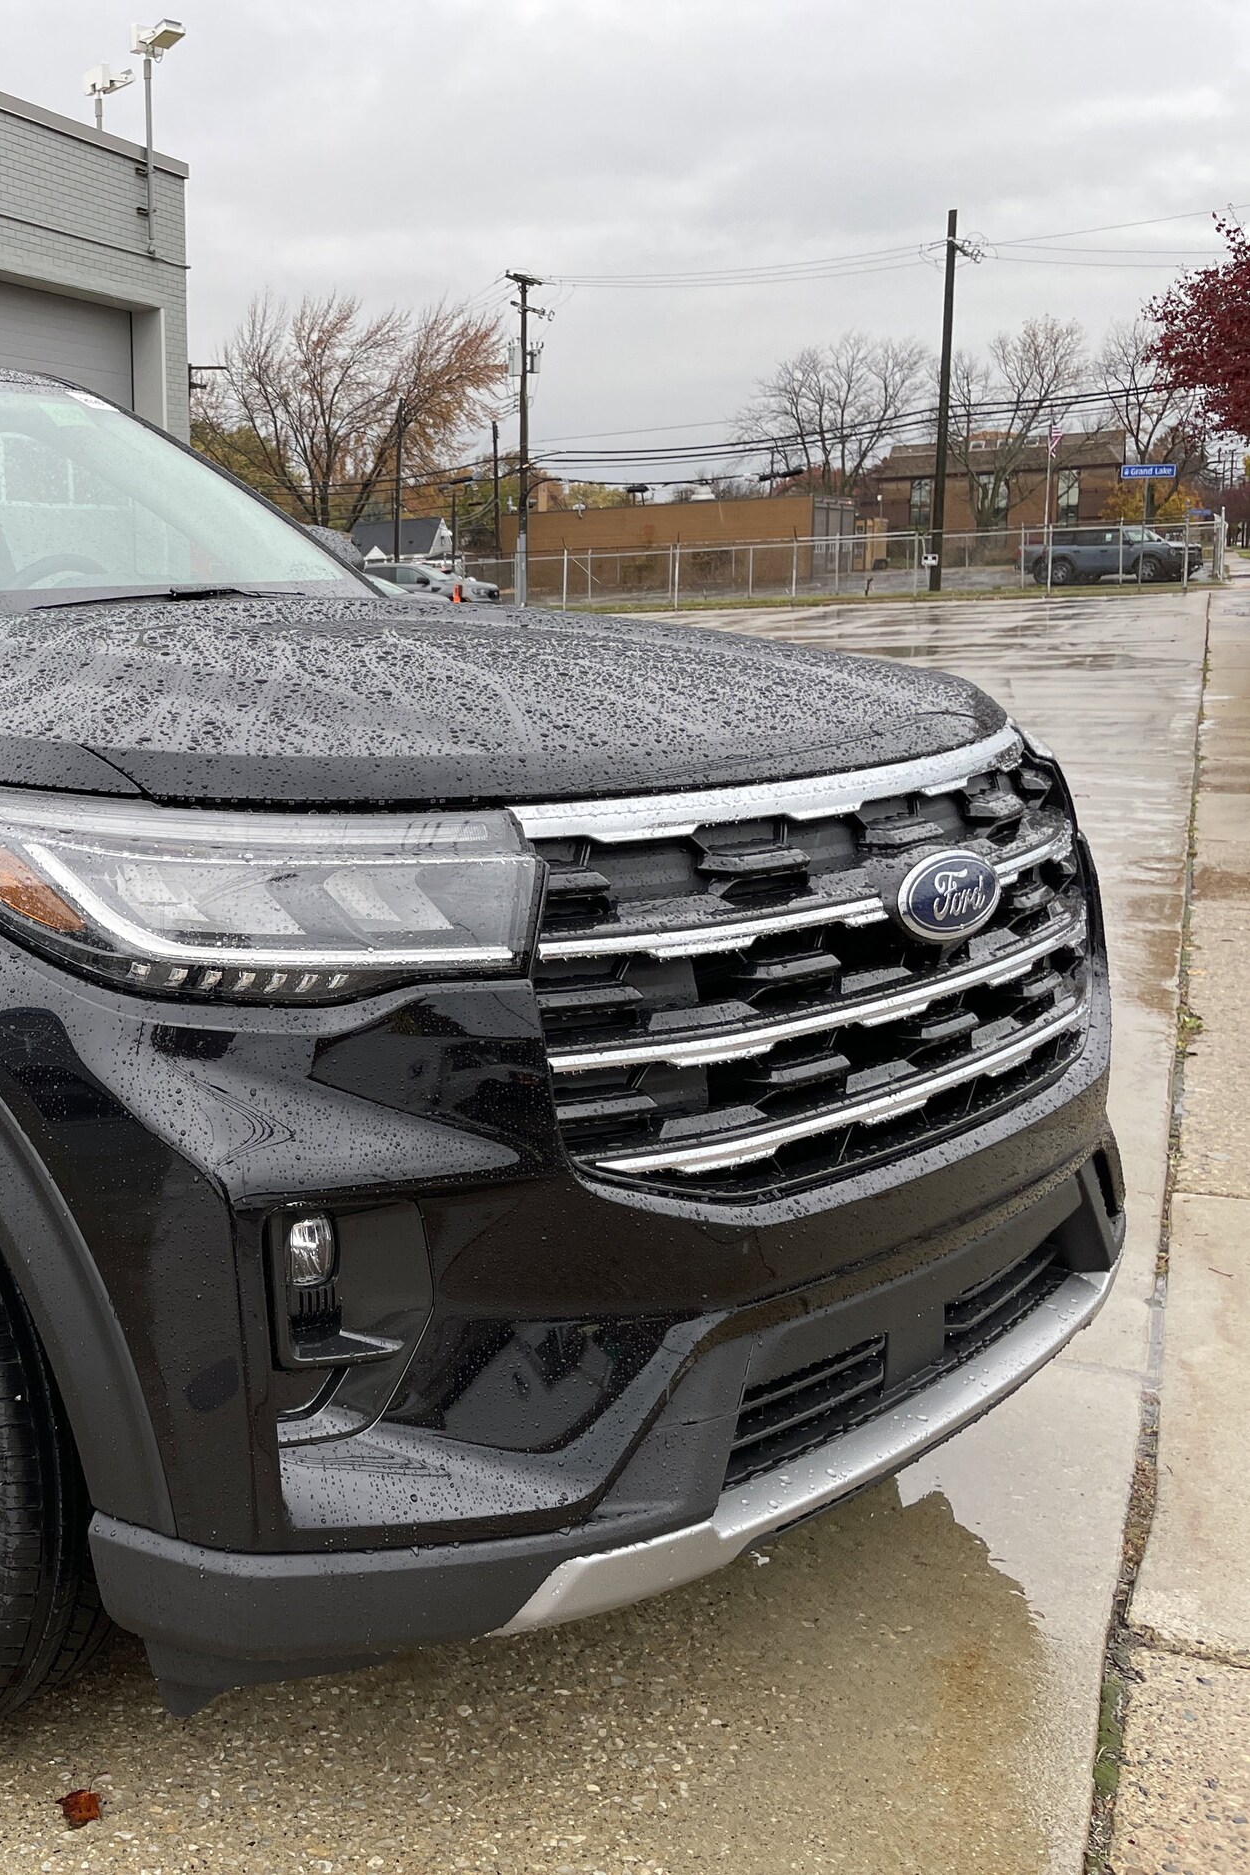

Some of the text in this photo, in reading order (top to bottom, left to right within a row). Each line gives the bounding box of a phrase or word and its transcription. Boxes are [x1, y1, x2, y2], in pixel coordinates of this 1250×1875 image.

[1130, 467, 1172, 476] Grand Lake
[933, 868, 986, 921] Ford
